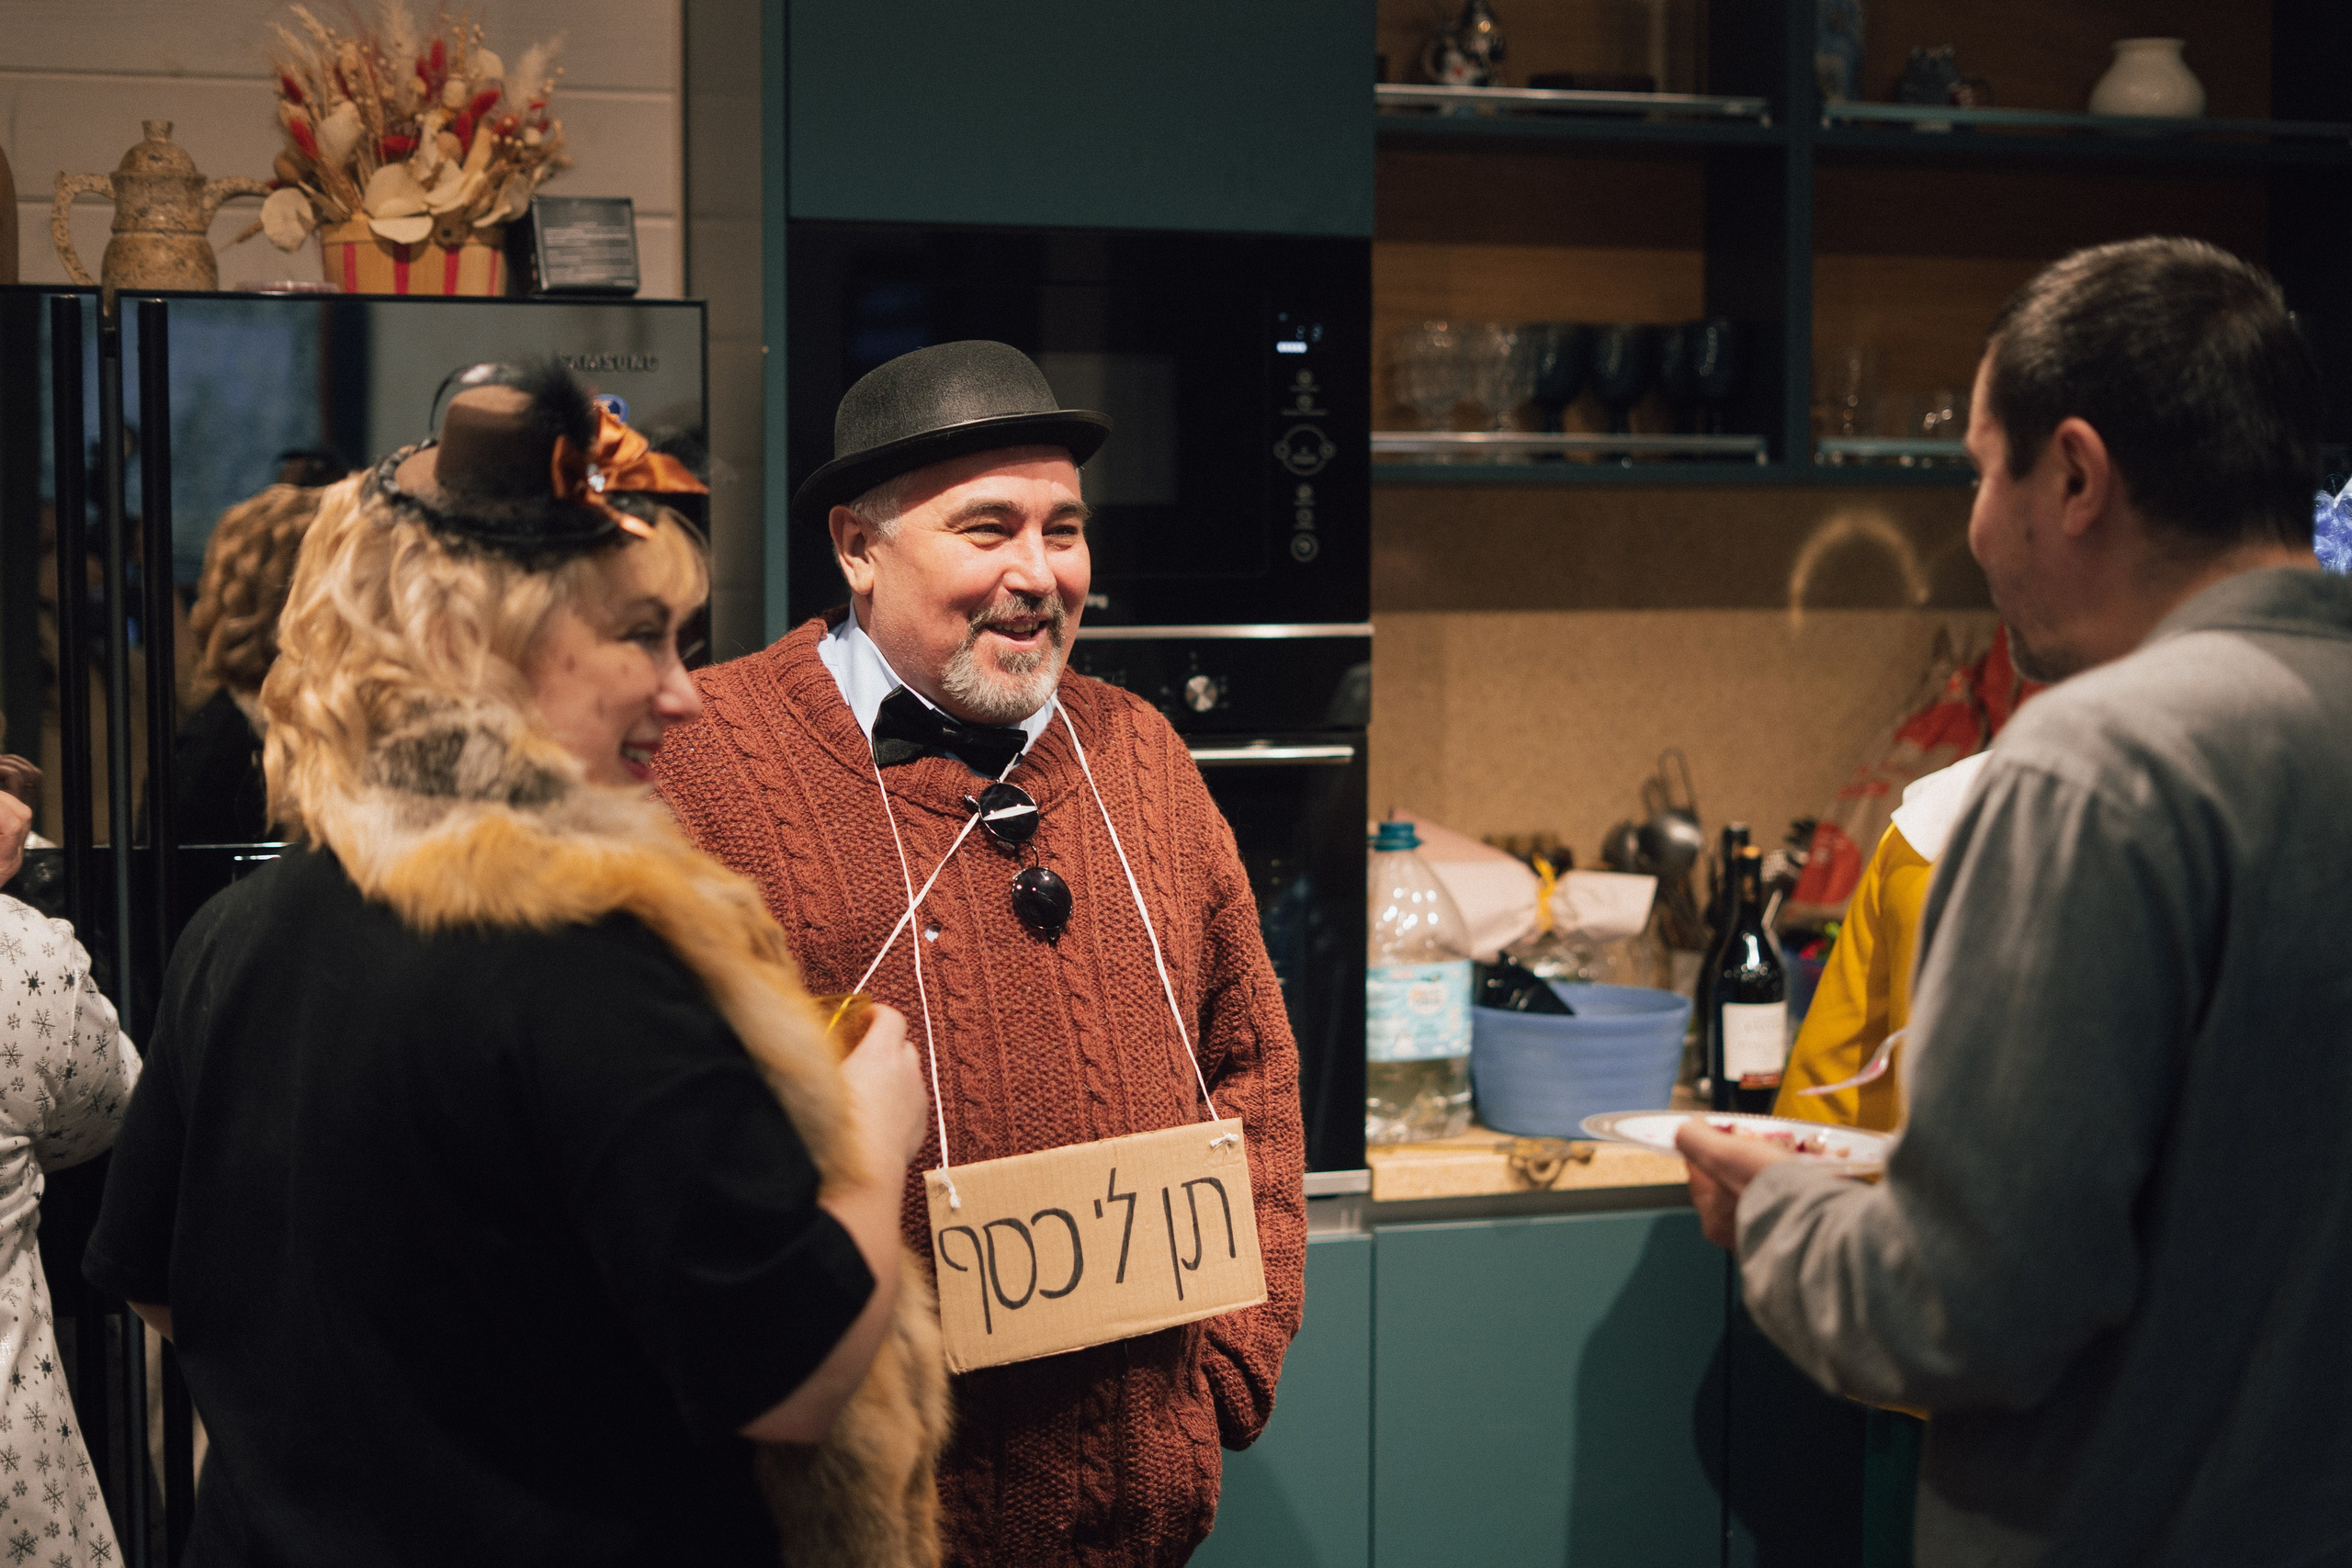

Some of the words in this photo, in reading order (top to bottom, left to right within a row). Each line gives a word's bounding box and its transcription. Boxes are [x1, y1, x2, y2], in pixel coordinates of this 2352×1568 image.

[937, 1207, 1084, 1336] כסף
[1093, 1167, 1137, 1284] לי
[1162, 1177, 1237, 1302] תן
